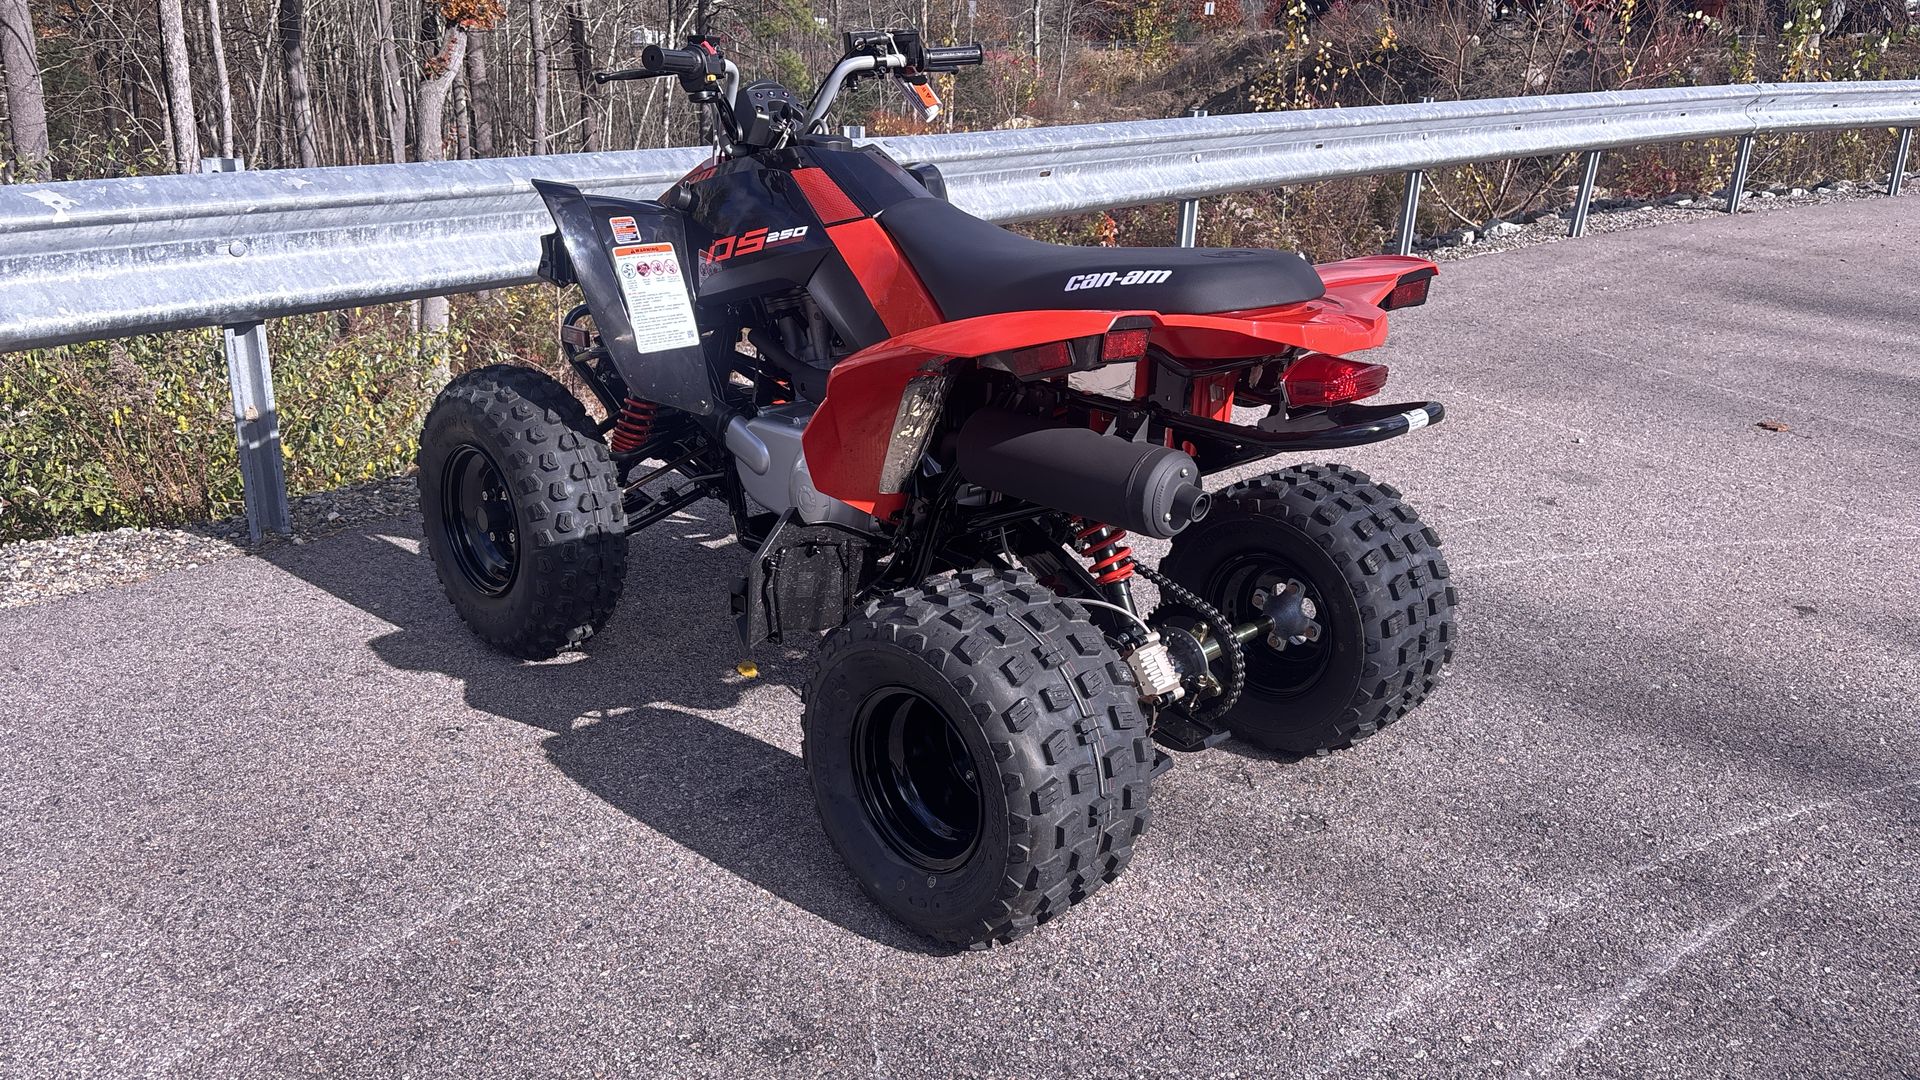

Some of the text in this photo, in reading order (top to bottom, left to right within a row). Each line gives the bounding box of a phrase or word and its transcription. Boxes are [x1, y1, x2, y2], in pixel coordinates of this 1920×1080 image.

[705, 226, 809, 264] DS 250
[1064, 269, 1173, 292] can-am
